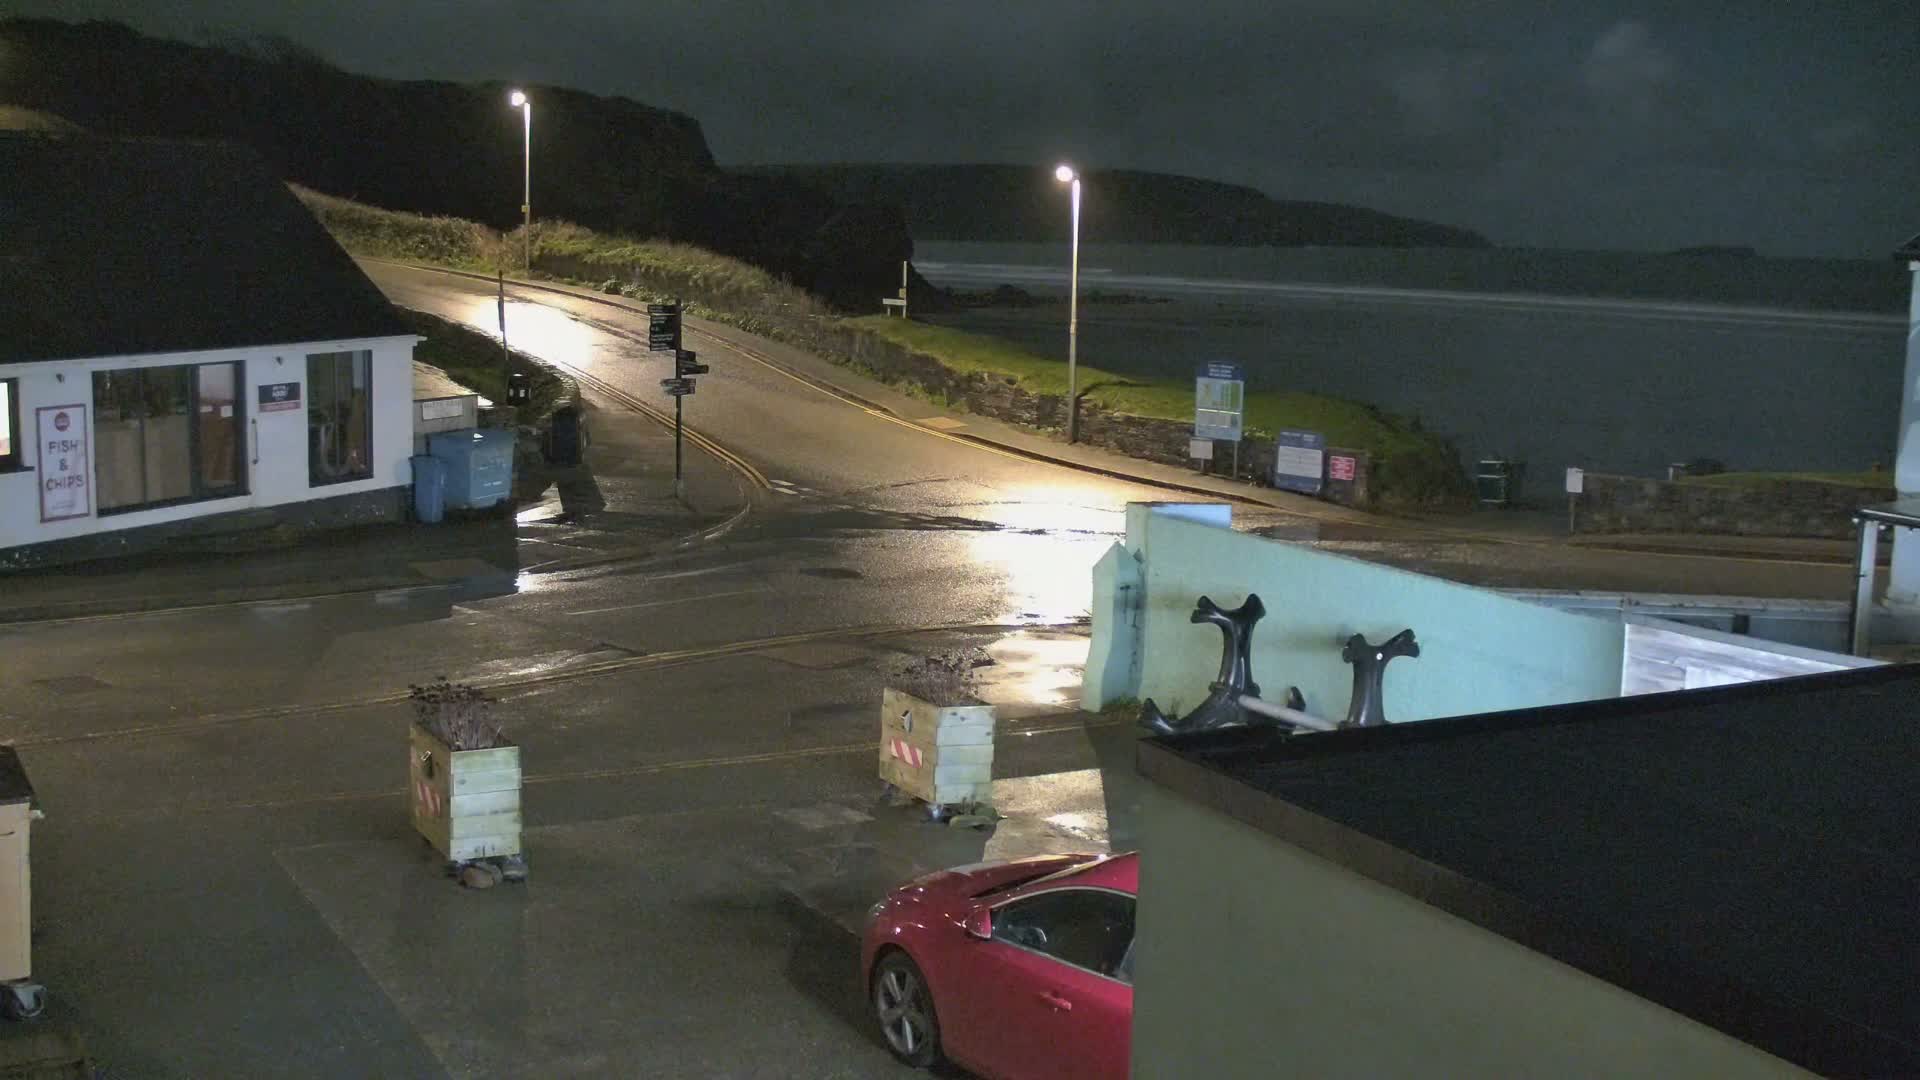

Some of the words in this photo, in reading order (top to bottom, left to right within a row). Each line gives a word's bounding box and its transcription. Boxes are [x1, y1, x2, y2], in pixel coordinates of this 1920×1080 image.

[48, 440, 78, 454] FISH
[59, 459, 69, 471] &
[46, 475, 84, 491] CHIPS
